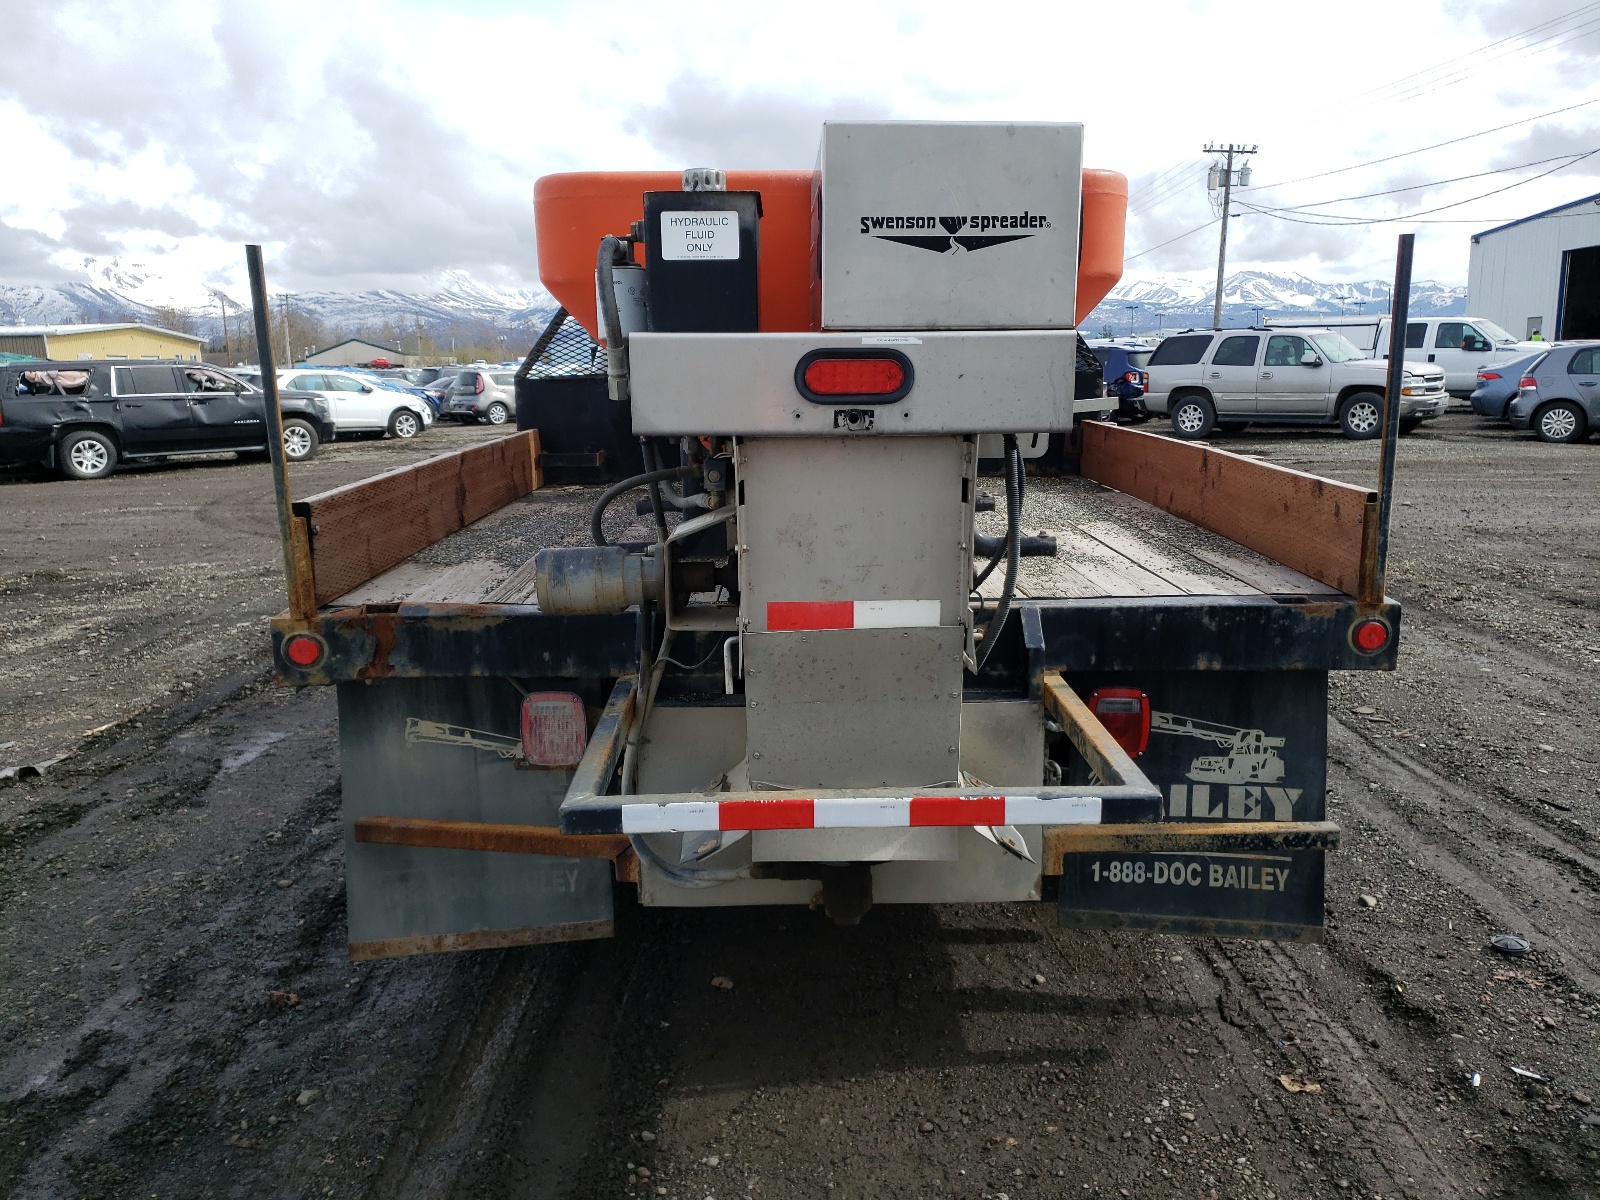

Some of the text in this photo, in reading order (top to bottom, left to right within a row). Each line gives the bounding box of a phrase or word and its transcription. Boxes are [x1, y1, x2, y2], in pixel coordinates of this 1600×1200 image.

[670, 217, 729, 227] HYDRAULIC
[685, 230, 715, 239] FLUID
[686, 243, 713, 252] ONLY
[1160, 784, 1304, 821] ILEY
[1091, 861, 1290, 892] 1-888-DOC BAILEY
